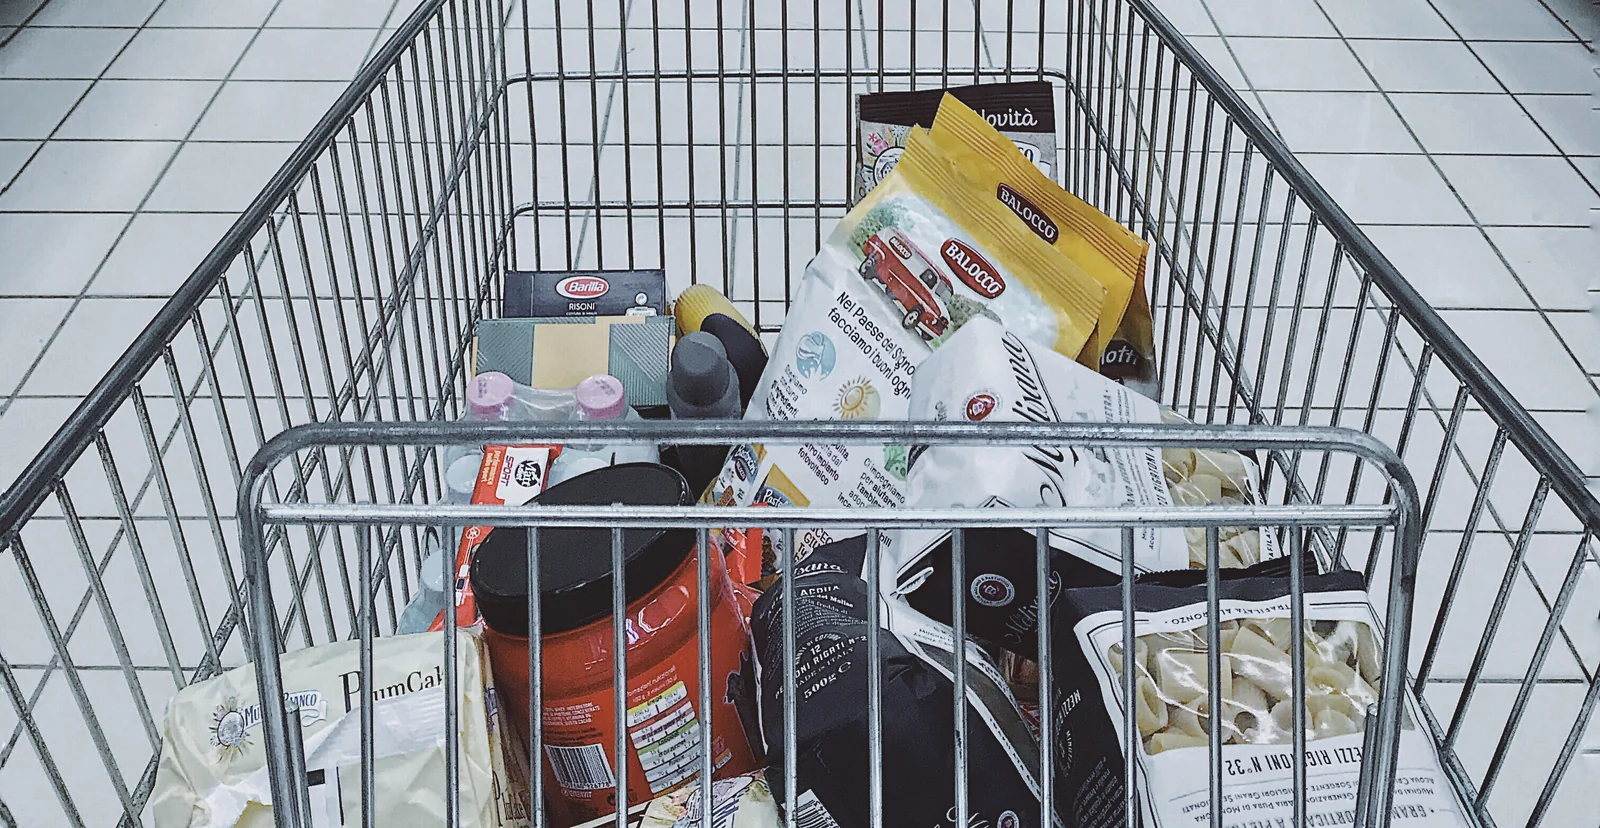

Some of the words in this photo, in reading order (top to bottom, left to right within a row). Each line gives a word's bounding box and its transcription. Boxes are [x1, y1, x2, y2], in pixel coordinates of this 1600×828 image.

[1000, 187, 1057, 240] BALOCCO
[945, 241, 1004, 295] BALOCCO
[568, 281, 604, 293] Barilla
[568, 302, 595, 310] RISONI
[828, 307, 872, 355] facciamo
[871, 352, 896, 379] buoni
[836, 291, 857, 313] Nel
[852, 307, 884, 342] Paese
[881, 338, 897, 354] del
[892, 347, 917, 376] Signo
[500, 455, 515, 487] SPORT
[798, 447, 829, 485] fotovoltaico
[817, 451, 839, 481] impianto
[1145, 452, 1165, 495] RIGATONI
[860, 471, 874, 486] per
[872, 482, 897, 508] aiutare
[869, 463, 906, 504] impegniamo
[1171, 611, 1209, 625] RONZO
[1235, 603, 1291, 614] TRAFILATA
[810, 644, 821, 655] 12
[812, 641, 845, 665] RIGATI
[826, 646, 854, 666] ITALY
[804, 672, 837, 699] 500g
[1061, 689, 1081, 718] MEZZI
[1268, 750, 1332, 771] RIGONI
[1234, 792, 1261, 801] GRANI
[1306, 791, 1355, 804] GENERAZION
[1310, 781, 1352, 792] SORGENTE
[1253, 801, 1276, 810] PURA
[1391, 804, 1427, 820] GRAN
